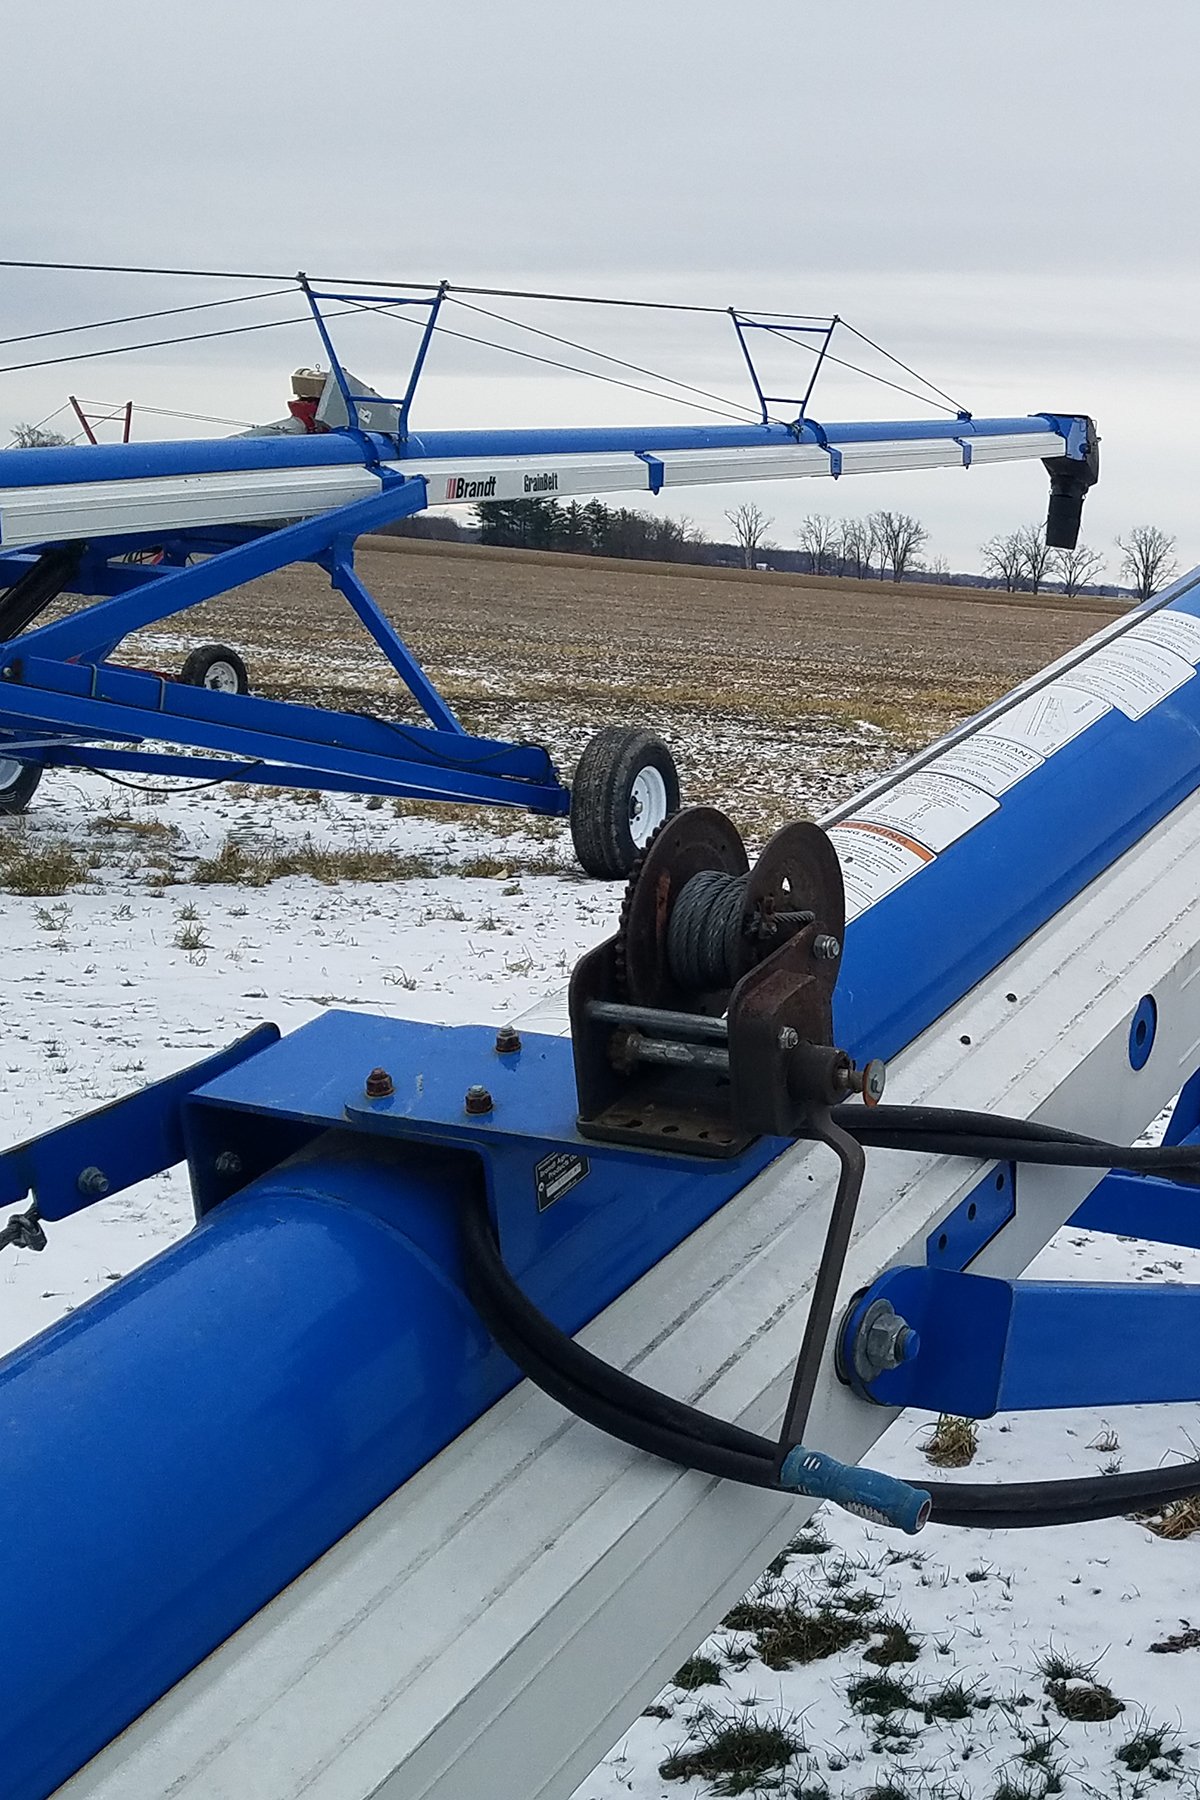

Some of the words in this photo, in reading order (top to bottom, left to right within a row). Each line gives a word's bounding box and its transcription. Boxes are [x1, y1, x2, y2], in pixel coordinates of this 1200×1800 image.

[456, 476, 497, 499] Brandt
[523, 472, 558, 493] GrainBelt
[968, 737, 1036, 761] MPORTANT
[861, 833, 903, 853] HAZARD
